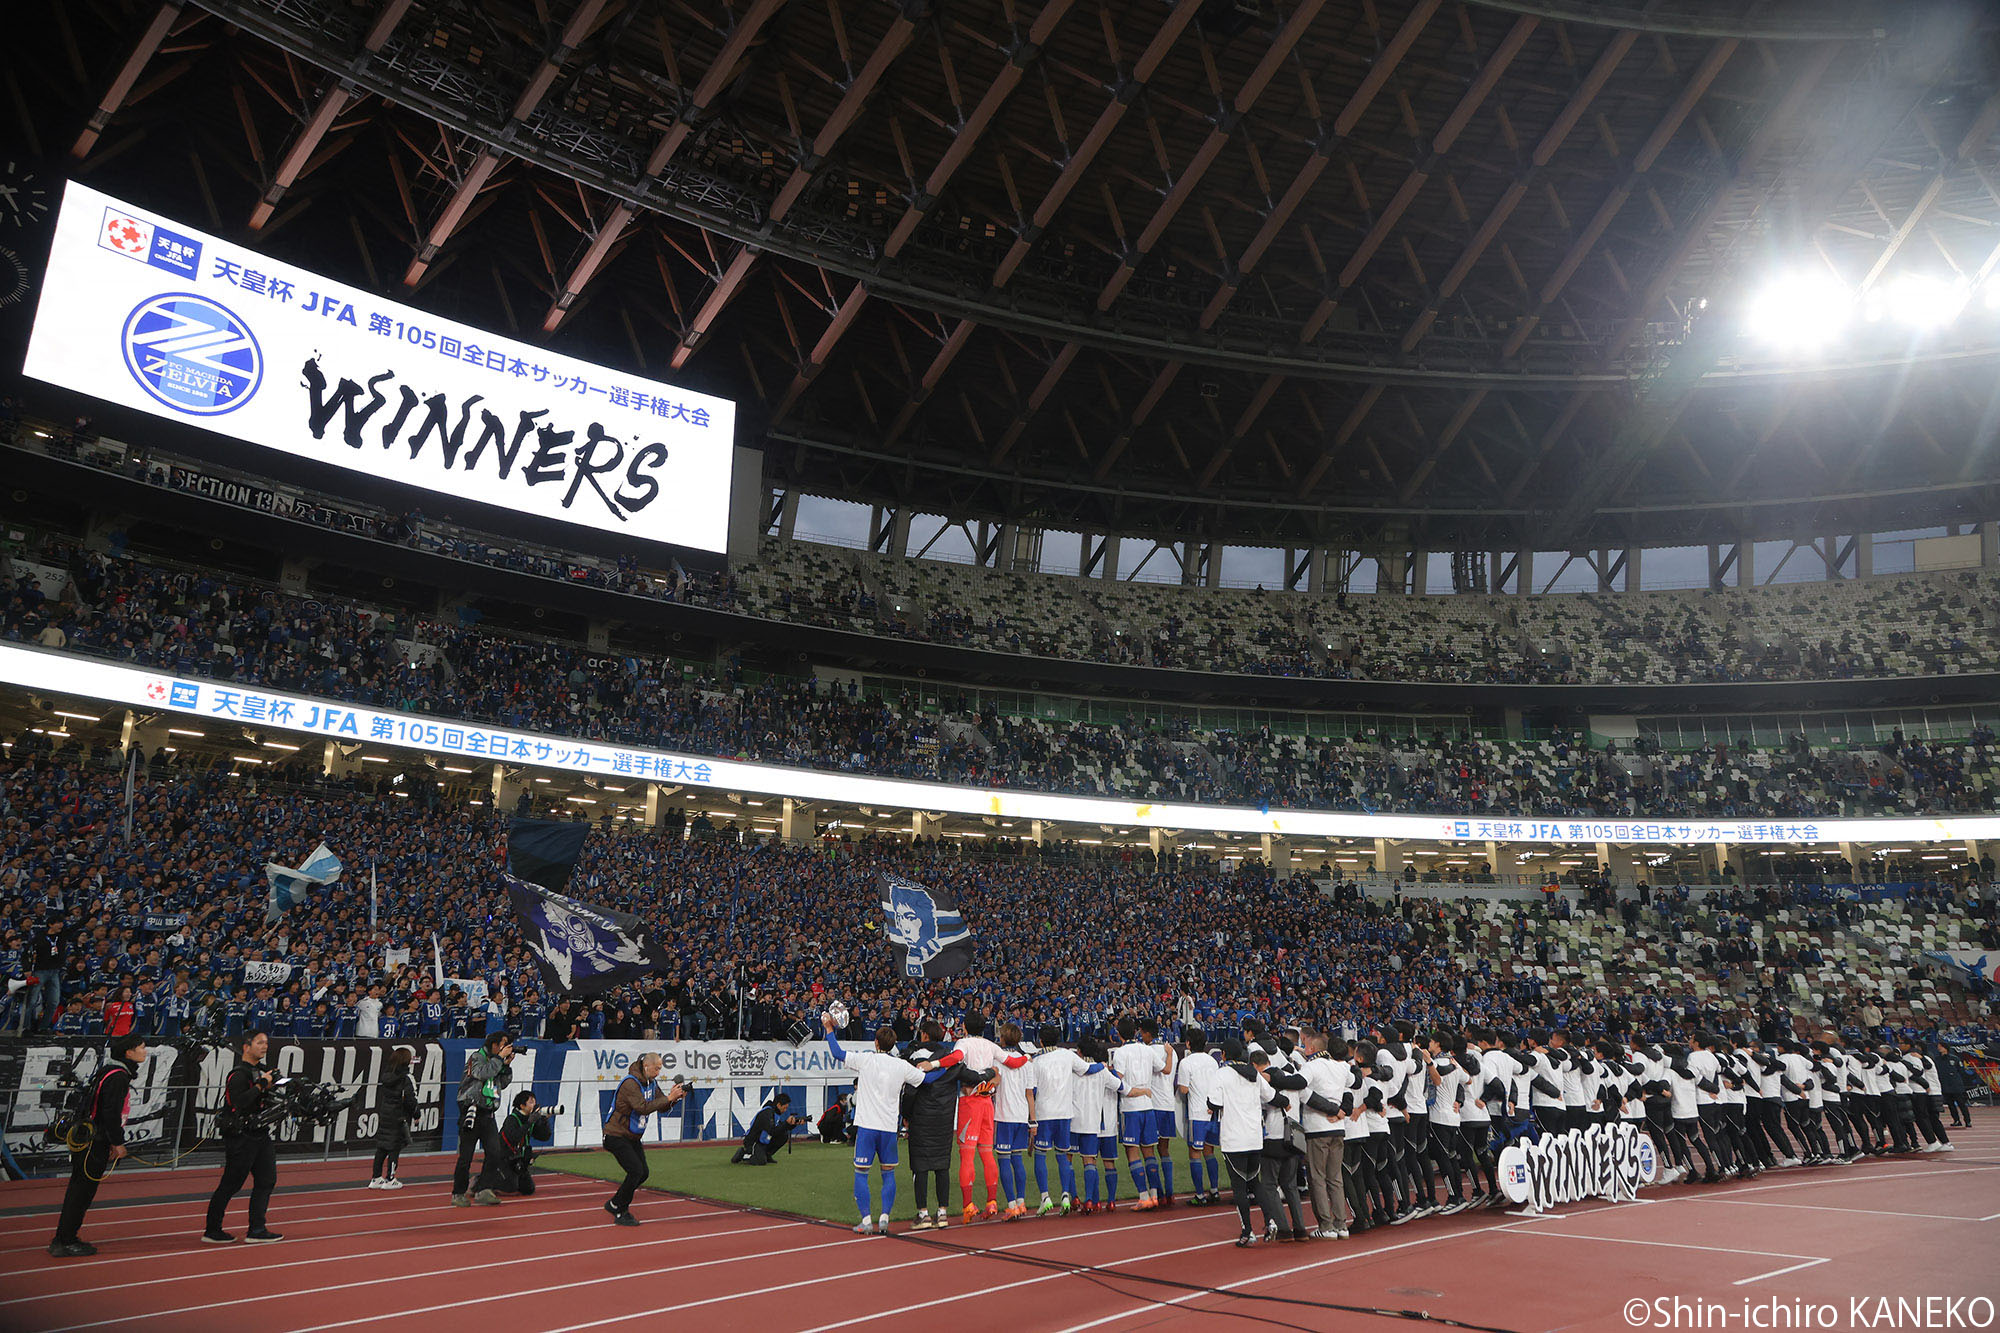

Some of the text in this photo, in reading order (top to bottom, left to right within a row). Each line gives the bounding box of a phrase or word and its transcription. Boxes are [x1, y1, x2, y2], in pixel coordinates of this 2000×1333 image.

[158, 237, 195, 258] 天皇杯
[166, 251, 183, 262] JFA
[213, 257, 710, 428] 天皇杯 JFA 第105回全日本サッカー選手権大会
[143, 354, 233, 398] ZELVIA
[169, 361, 234, 387] FC MACHIDA
[301, 351, 668, 521] WINNERS
[44, 571, 65, 583] 252
[213, 690, 711, 783] 天皇杯 JFA 第105回全日本サッカー選手権大会
[1478, 822, 1523, 839] 天皇杯
[1529, 823, 1563, 840] JFA
[1569, 824, 1819, 841] 第105回全日本サッカー選手権大会
[594, 1049, 629, 1070] We
[683, 1047, 721, 1071] the
[1525, 1123, 1640, 1211] WINNERS
